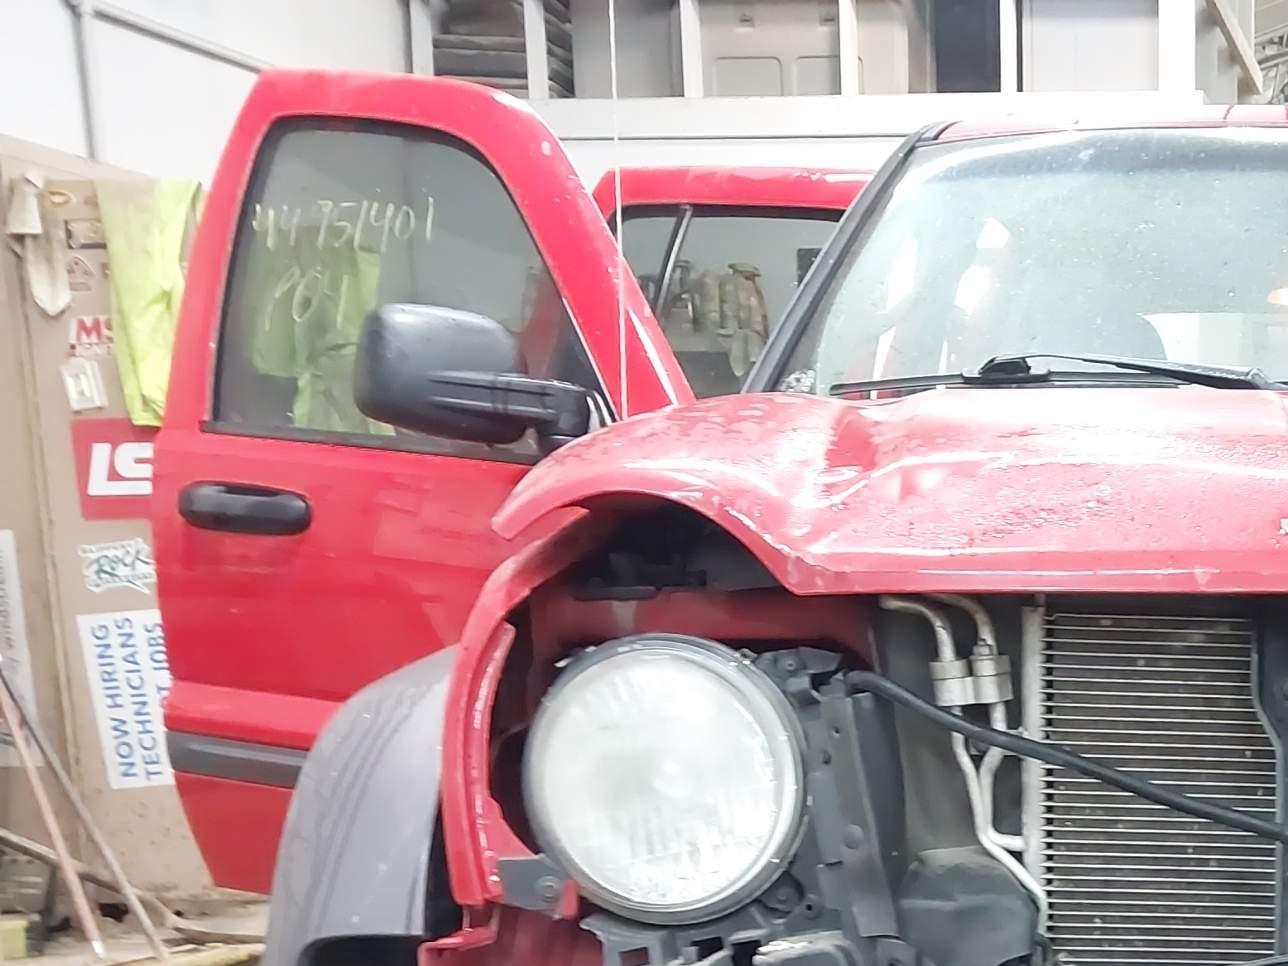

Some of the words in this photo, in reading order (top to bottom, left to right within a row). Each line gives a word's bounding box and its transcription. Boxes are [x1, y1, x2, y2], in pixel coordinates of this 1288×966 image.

[91, 624, 123, 709] HIRING
[114, 616, 163, 781] TECHNICIANS
[108, 717, 138, 778] NOW
